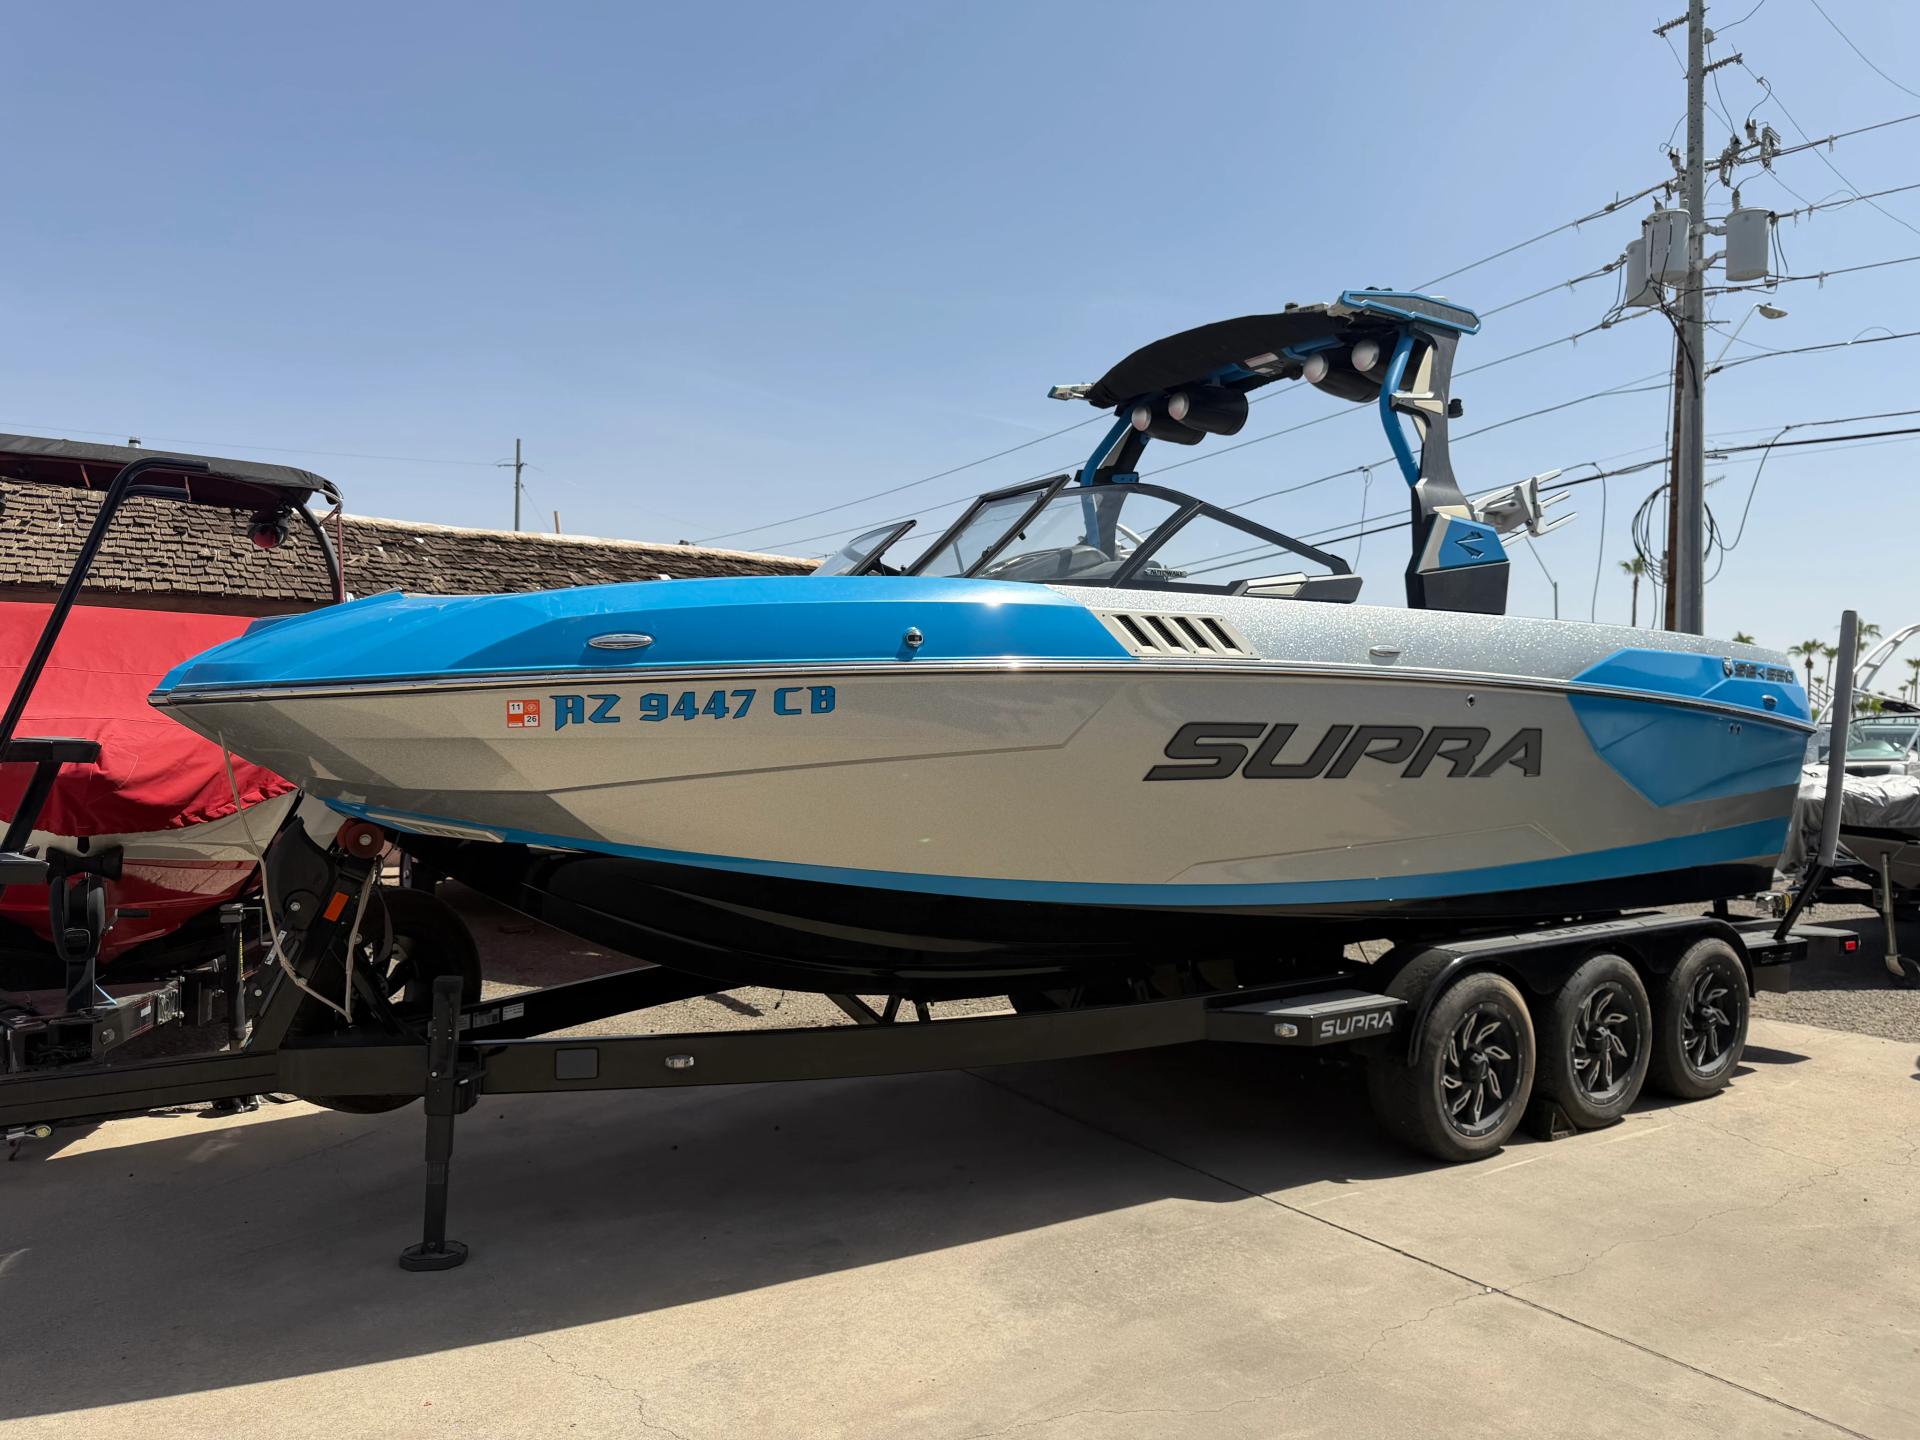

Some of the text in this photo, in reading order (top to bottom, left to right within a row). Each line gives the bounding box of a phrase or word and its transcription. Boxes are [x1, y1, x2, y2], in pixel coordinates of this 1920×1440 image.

[511, 703, 520, 711] 11
[526, 715, 537, 723] 26
[549, 685, 836, 731] AZ 9447 CB
[1142, 721, 1543, 782] SUPRA
[1319, 1010, 1395, 1038] SUPRA
